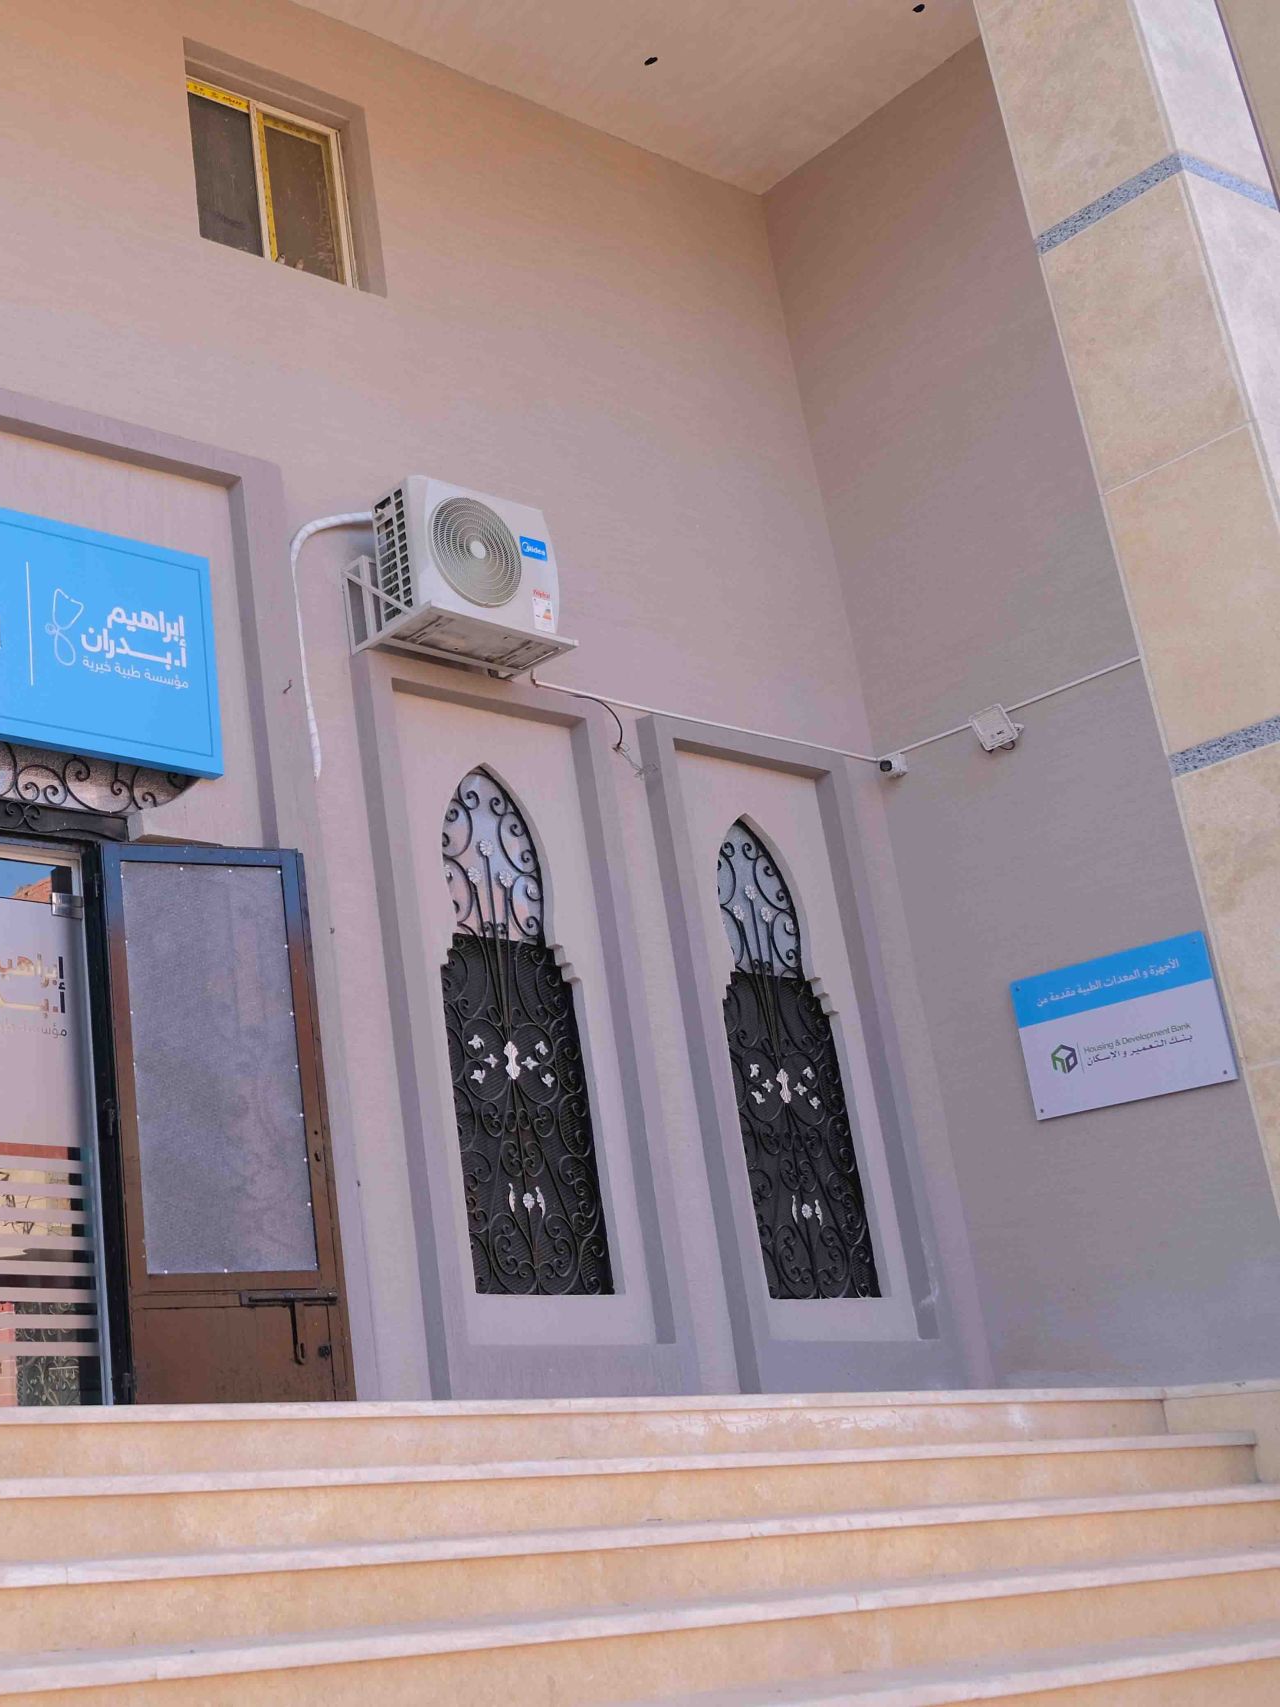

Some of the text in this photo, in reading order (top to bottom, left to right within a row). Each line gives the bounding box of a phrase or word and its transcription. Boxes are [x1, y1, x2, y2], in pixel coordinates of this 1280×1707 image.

[107, 606, 186, 645] إبراهيم
[82, 655, 189, 689] مؤسسة طبية خيرية
[1077, 980, 1103, 996] الطبية
[1103, 968, 1141, 987] المعدات
[1036, 997, 1049, 1007] من
[1084, 1023, 1191, 1053] Housing & Development Bank
